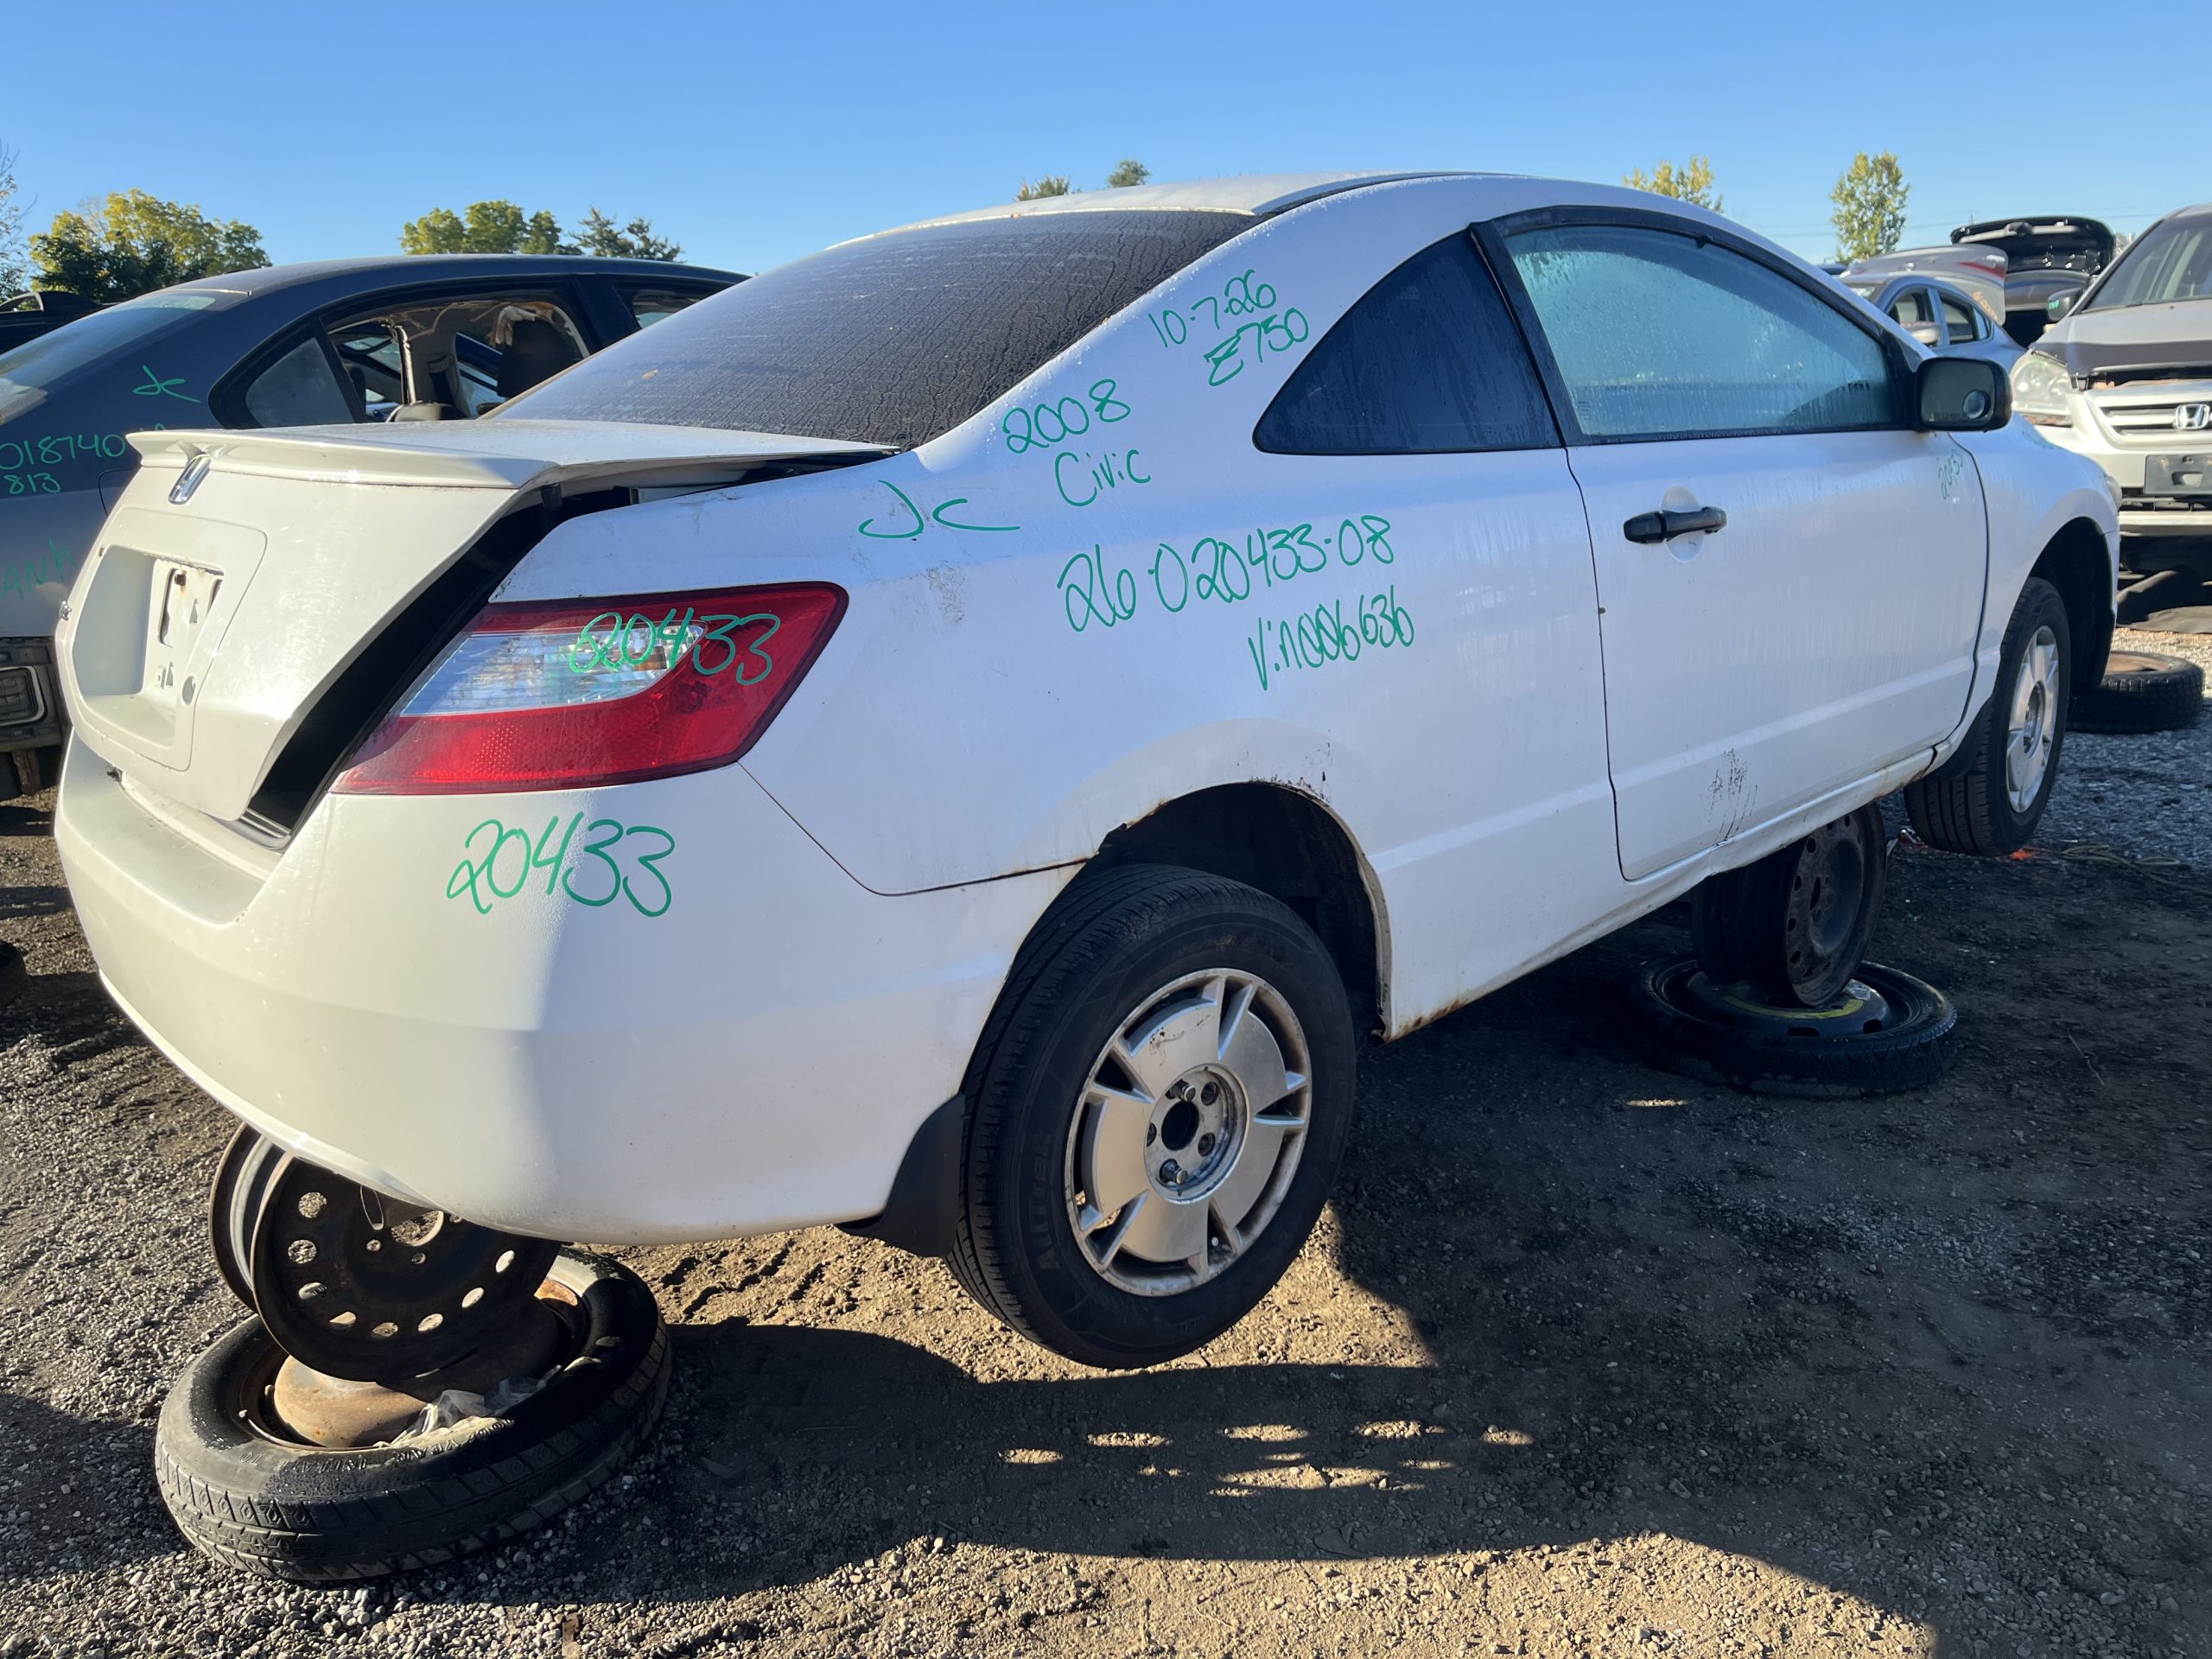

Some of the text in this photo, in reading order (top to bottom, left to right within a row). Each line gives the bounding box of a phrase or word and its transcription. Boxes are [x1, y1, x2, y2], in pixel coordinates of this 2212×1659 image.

[0, 423, 165, 470] 018740
[1002, 378, 1132, 454] 2008
[1054, 448, 1151, 507] Civic
[446, 811, 675, 918] 20433
